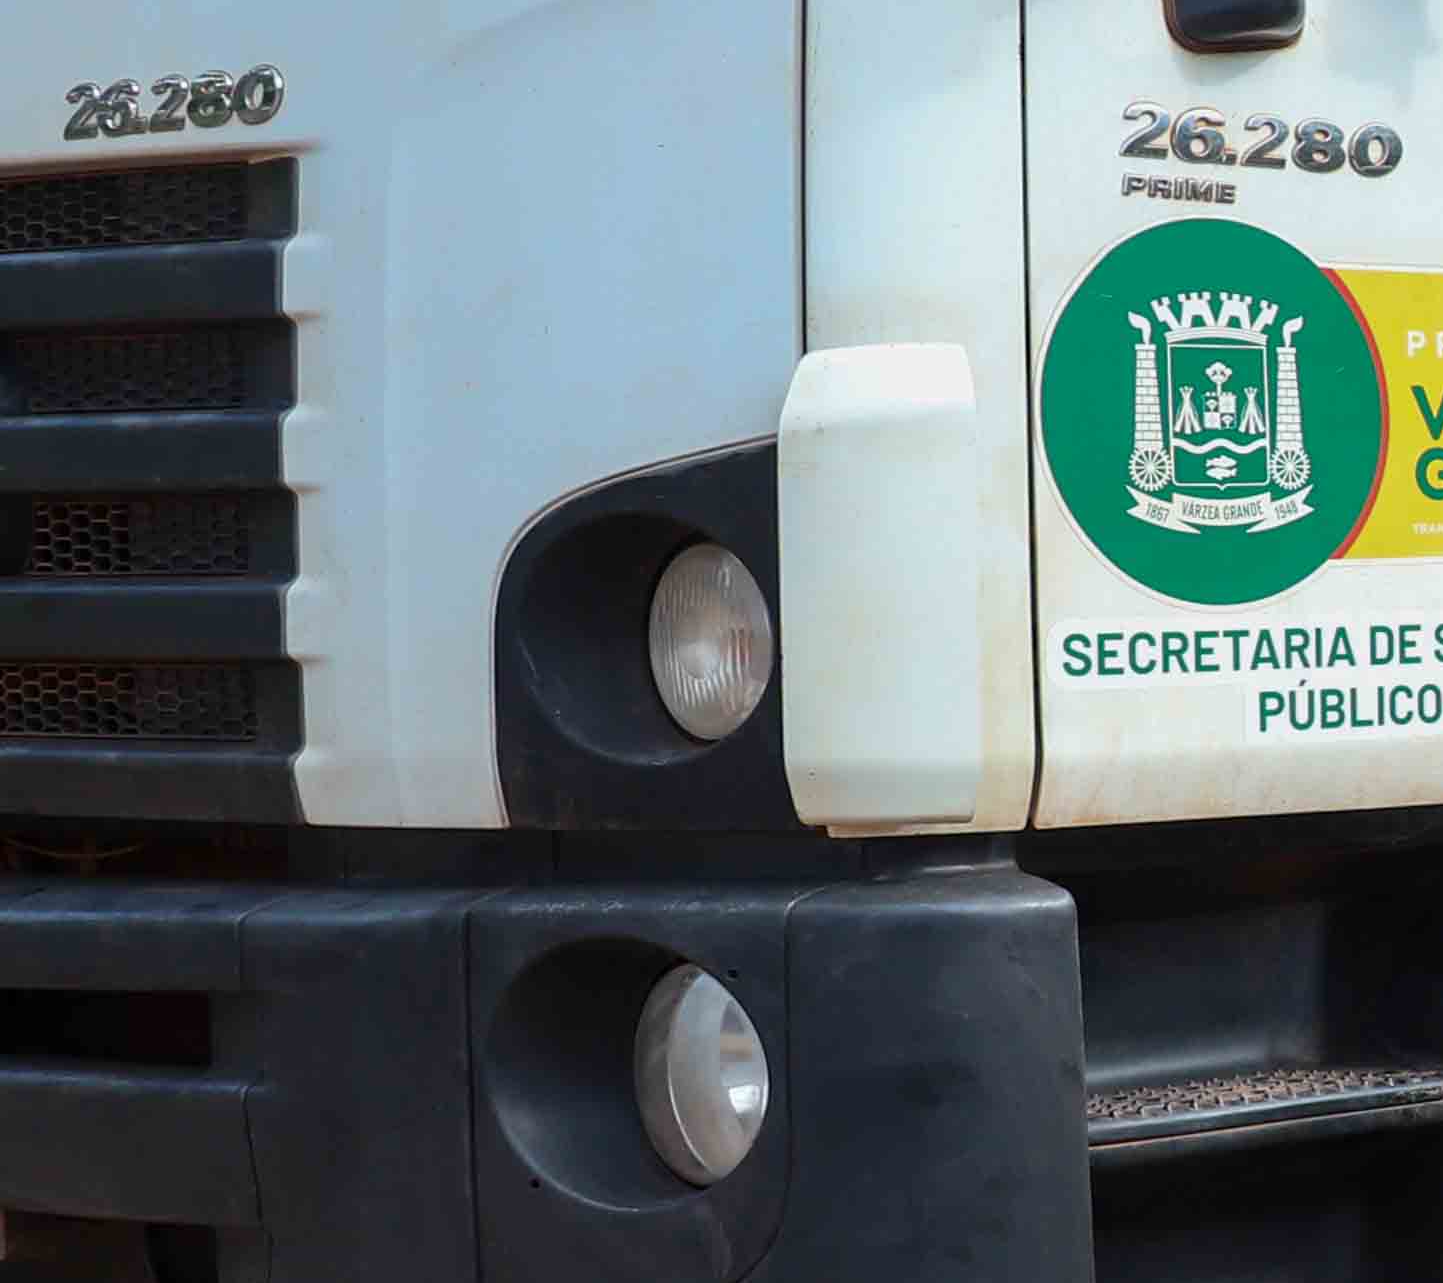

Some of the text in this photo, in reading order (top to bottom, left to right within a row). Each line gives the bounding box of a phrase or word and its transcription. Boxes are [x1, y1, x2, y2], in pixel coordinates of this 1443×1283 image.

[63, 63, 285, 142] 26.280
[1118, 100, 1403, 178] 26.280
[1121, 173, 1237, 205] PRIME
[1223, 500, 1265, 520] GRANDE
[1062, 626, 1356, 677] SECRETARIA
[1369, 624, 1422, 667] DE
